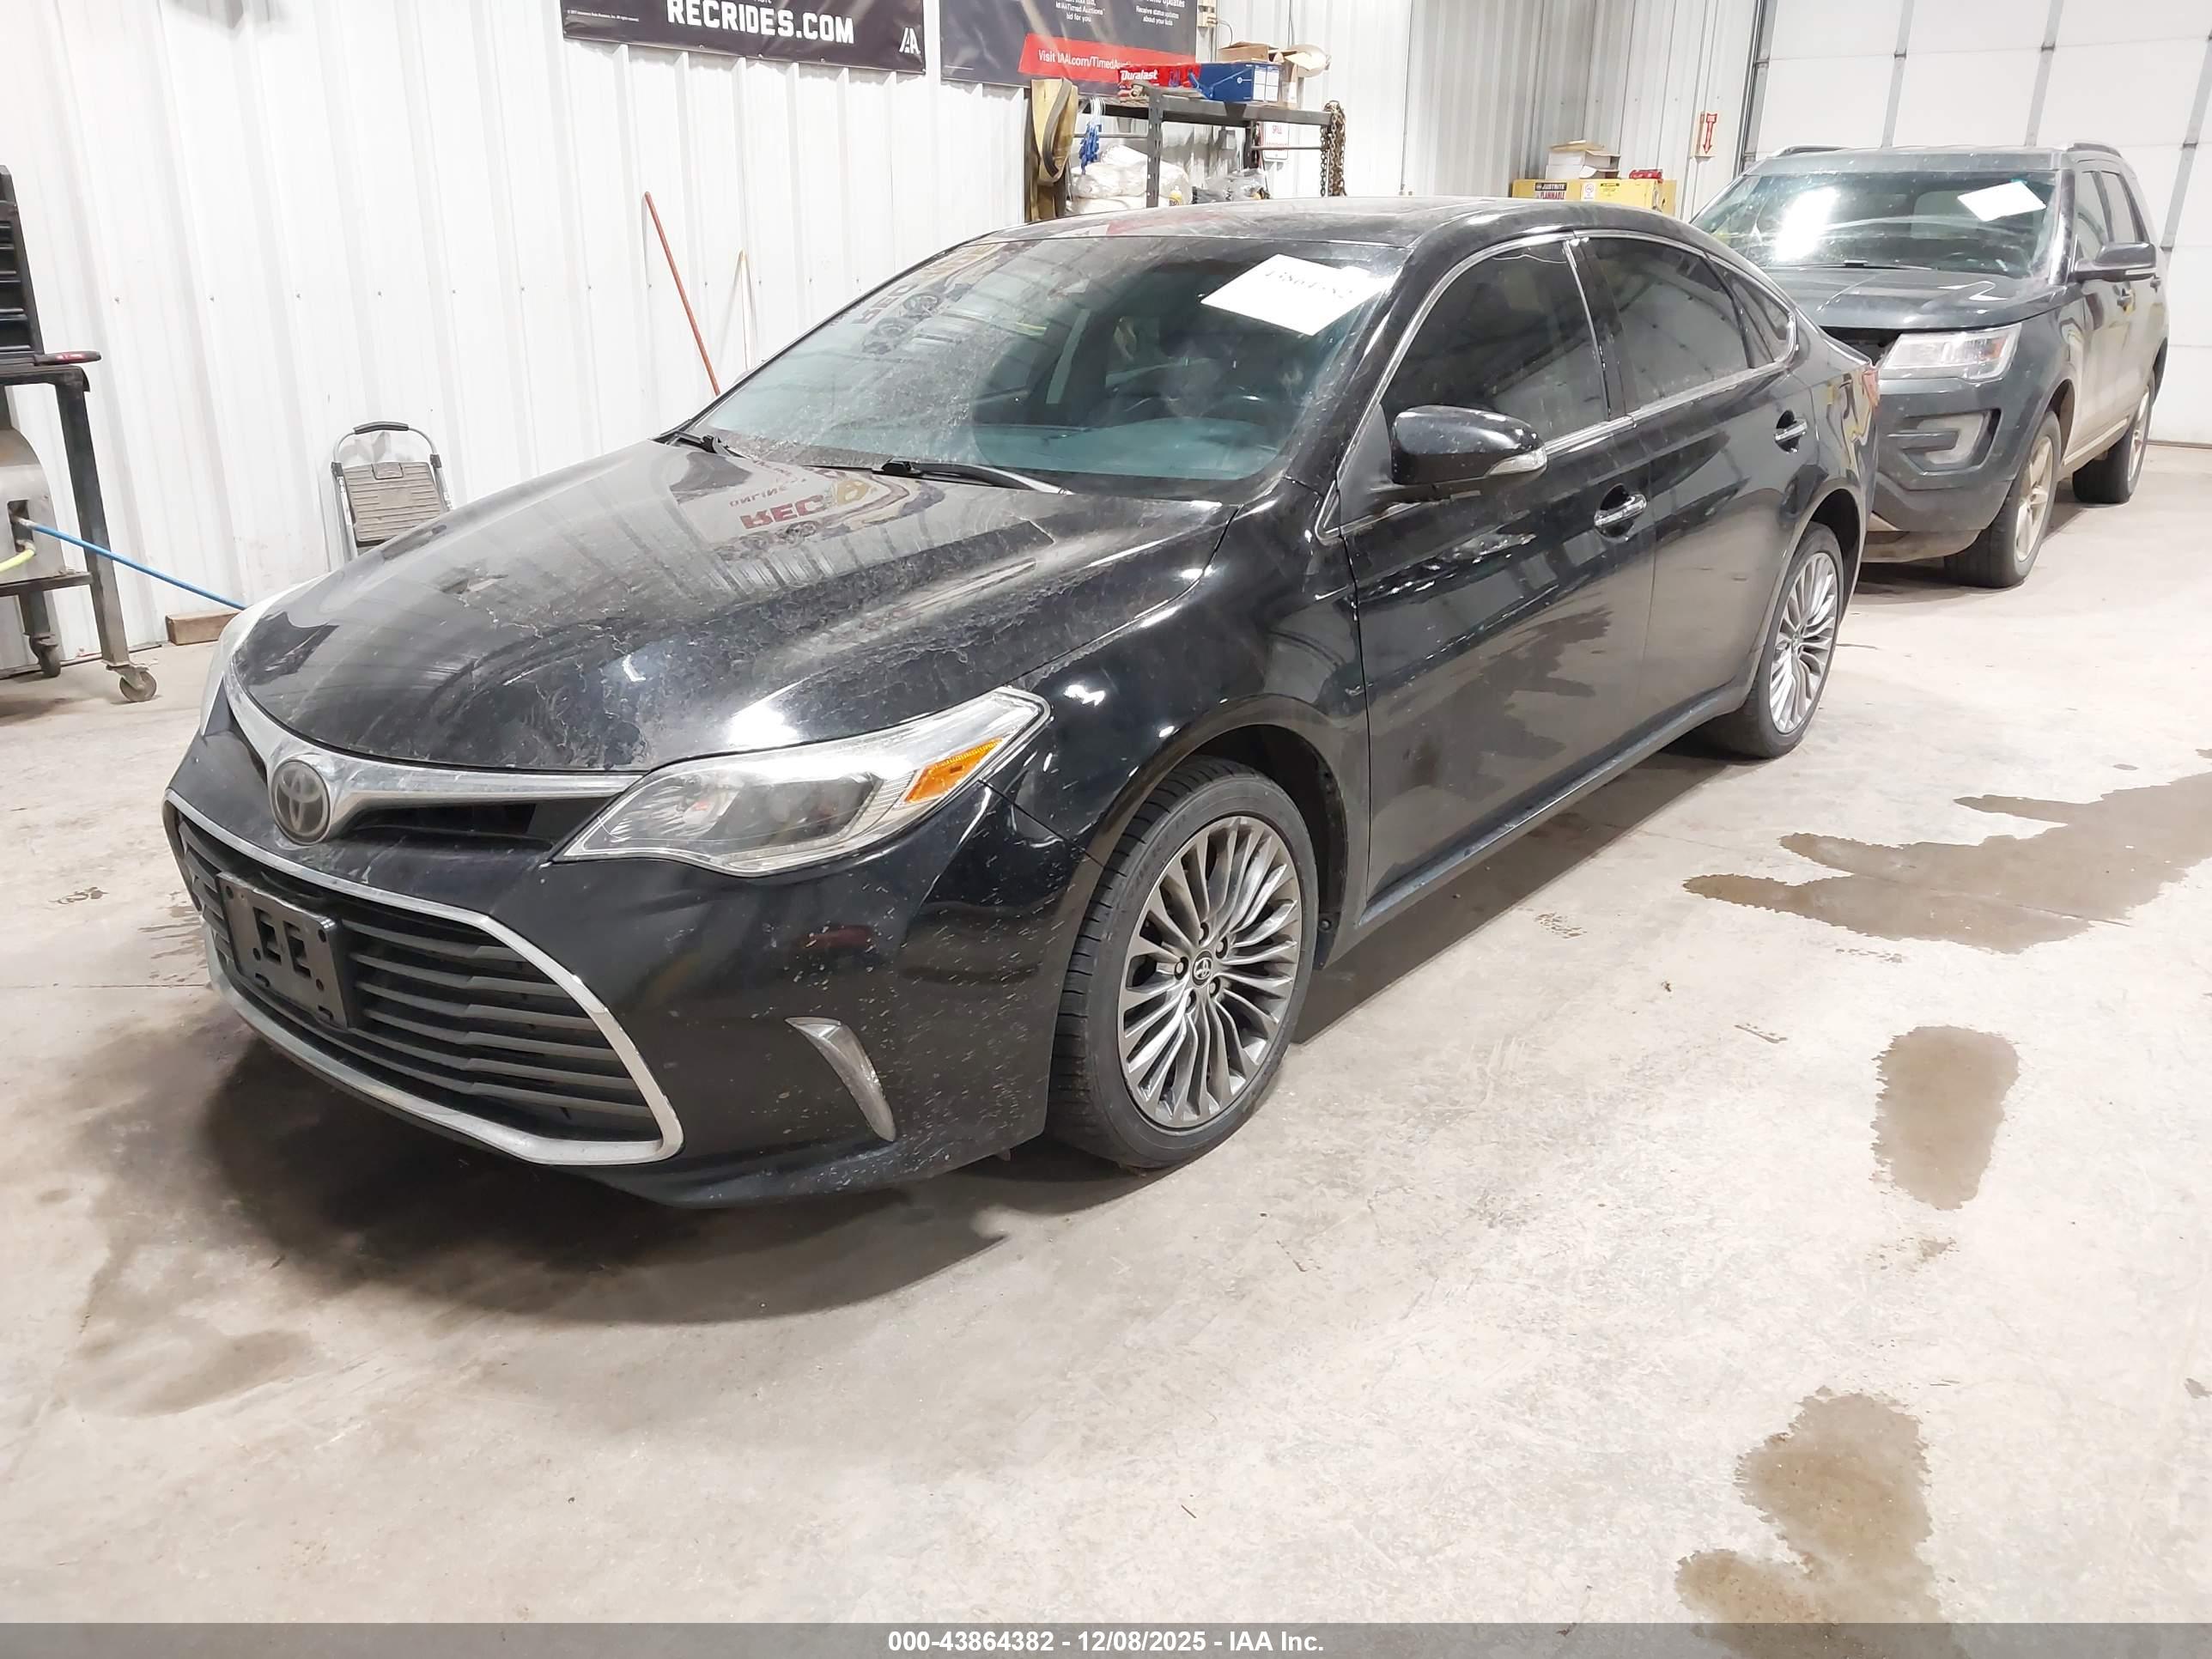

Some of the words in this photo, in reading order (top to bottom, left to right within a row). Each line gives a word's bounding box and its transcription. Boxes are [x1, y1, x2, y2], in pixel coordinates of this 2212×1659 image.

[666, 0, 854, 44] RECRIDES.COM
[1038, 49, 1056, 63] Visit
[1119, 69, 1159, 81] Duralast
